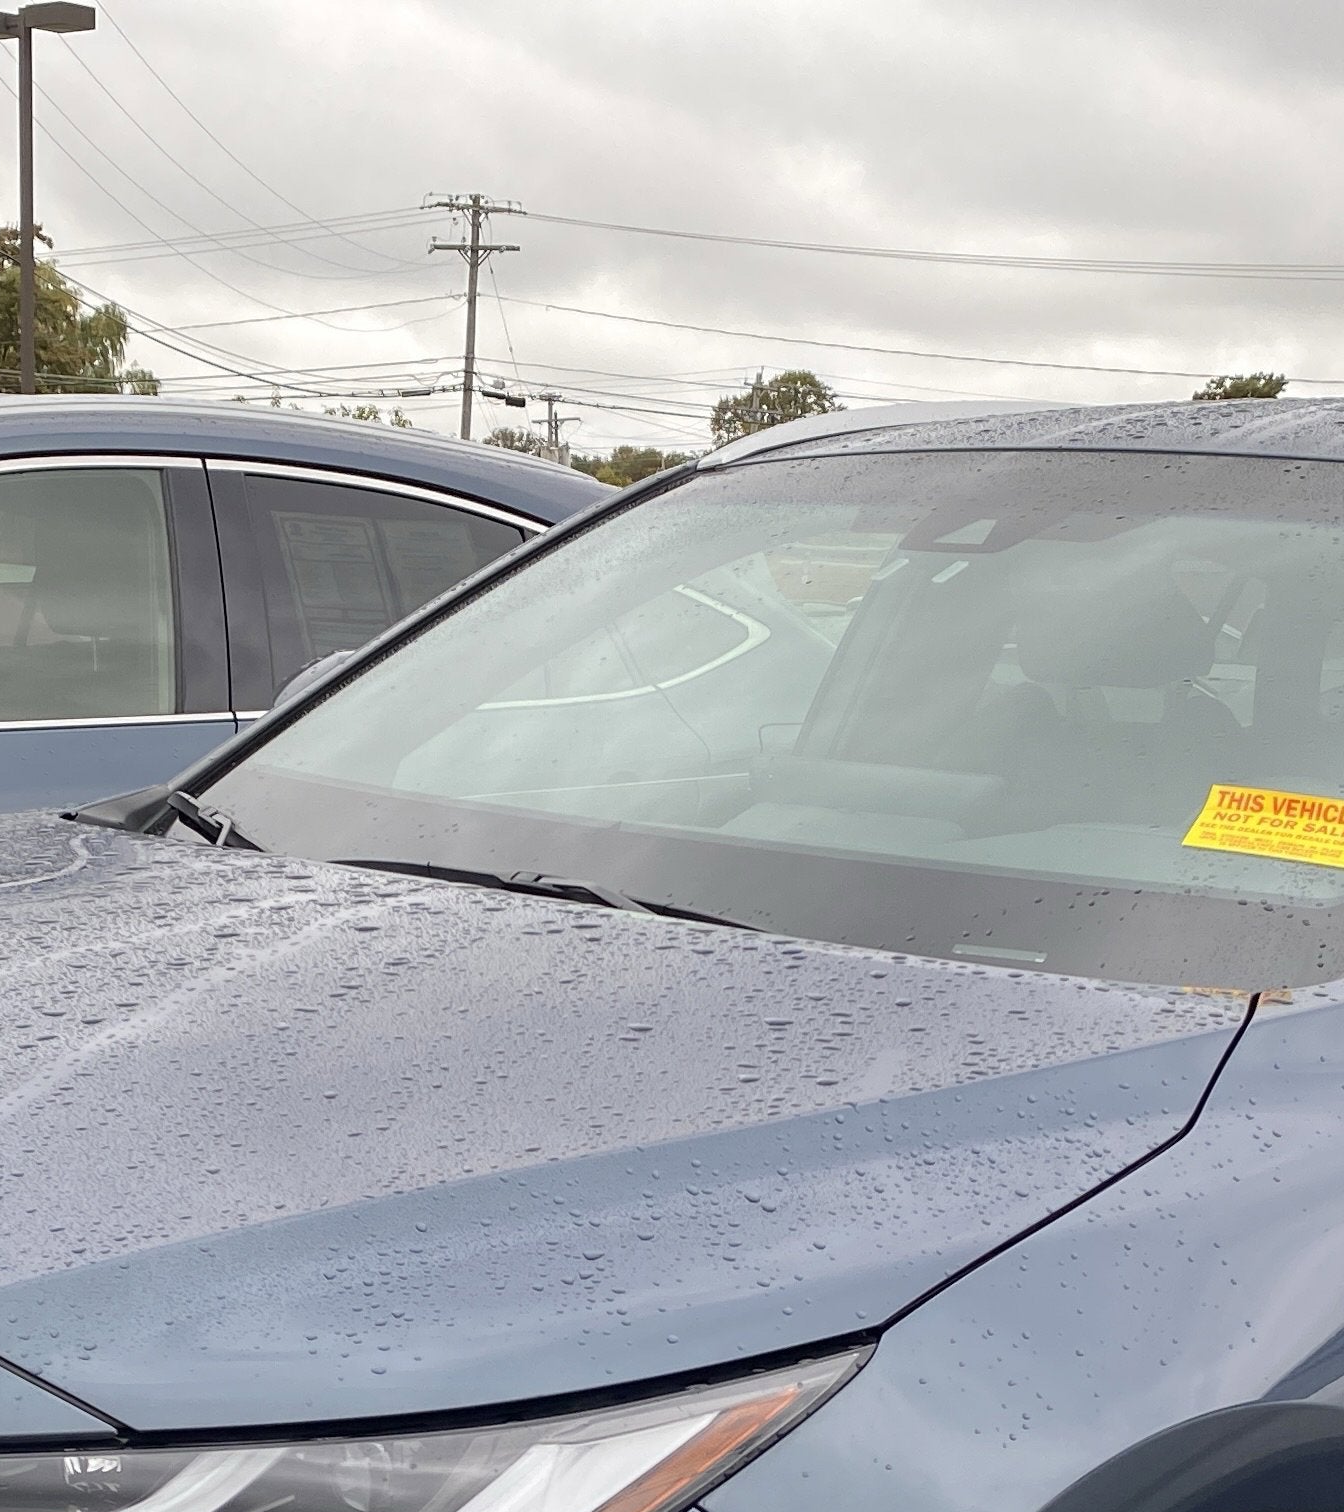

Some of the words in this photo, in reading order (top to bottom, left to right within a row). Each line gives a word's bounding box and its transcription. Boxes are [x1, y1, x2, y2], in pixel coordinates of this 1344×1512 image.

[1216, 790, 1265, 813] THIS
[1212, 811, 1253, 823] NOT
[1256, 817, 1299, 831] FOR
